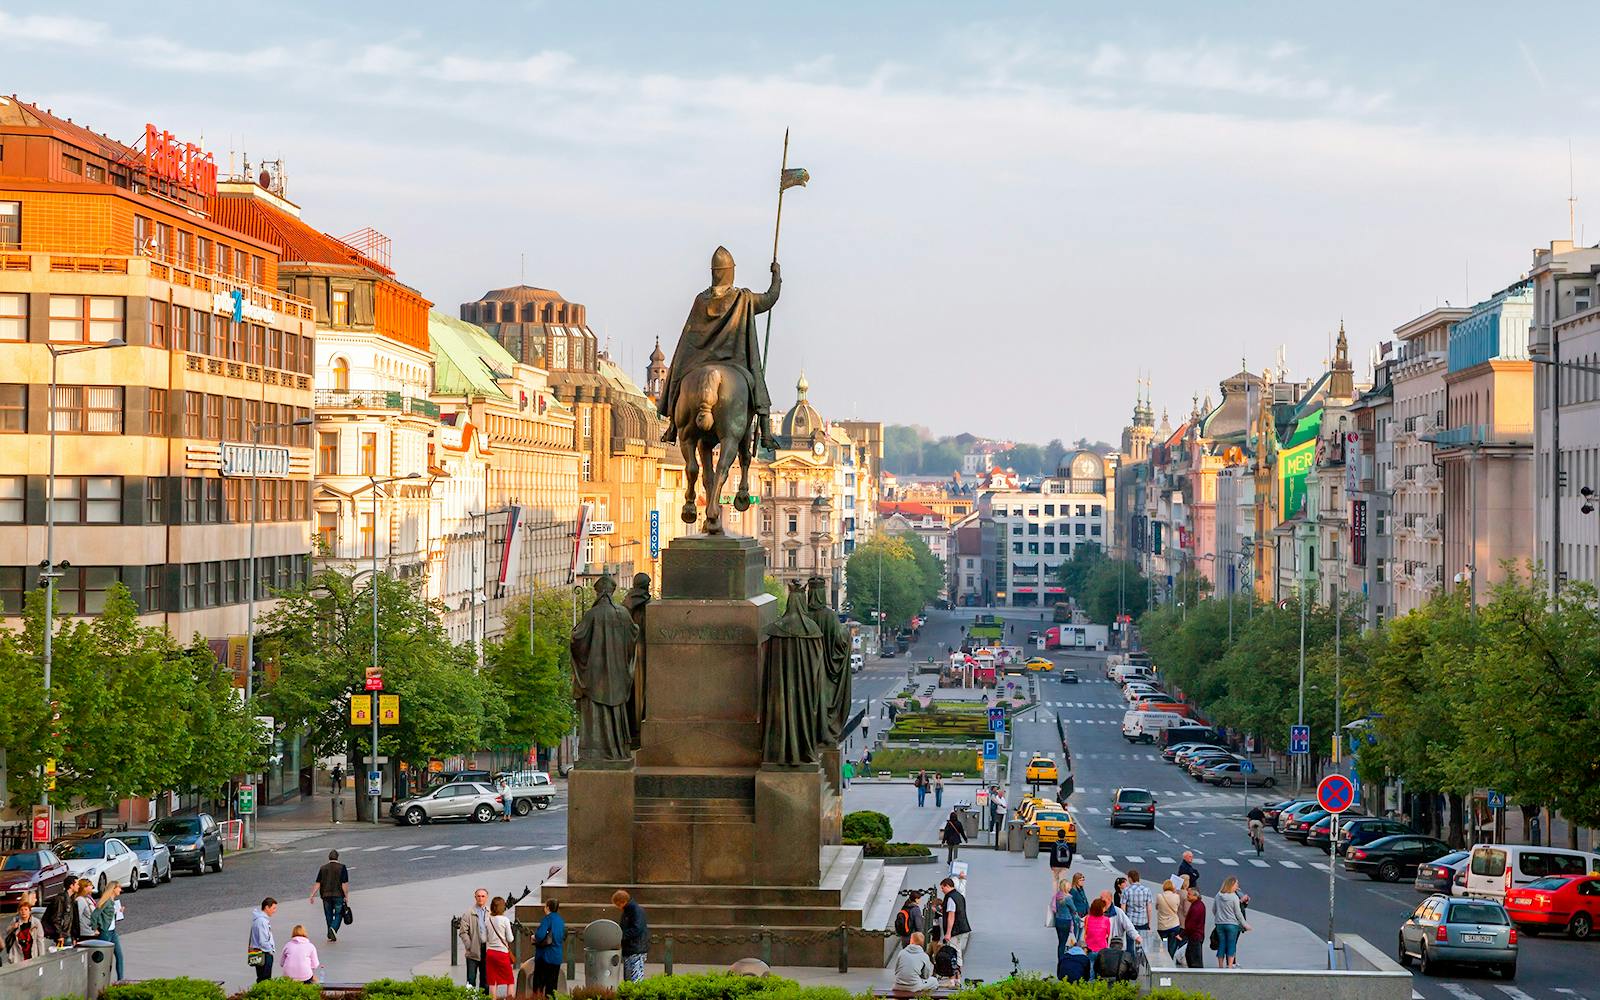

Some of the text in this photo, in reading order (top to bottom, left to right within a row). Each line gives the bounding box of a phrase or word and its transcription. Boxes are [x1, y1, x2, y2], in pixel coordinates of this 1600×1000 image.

[1287, 452, 1313, 474] MER
[1349, 447, 1357, 497] RAMADA
[986, 742, 995, 755] P
